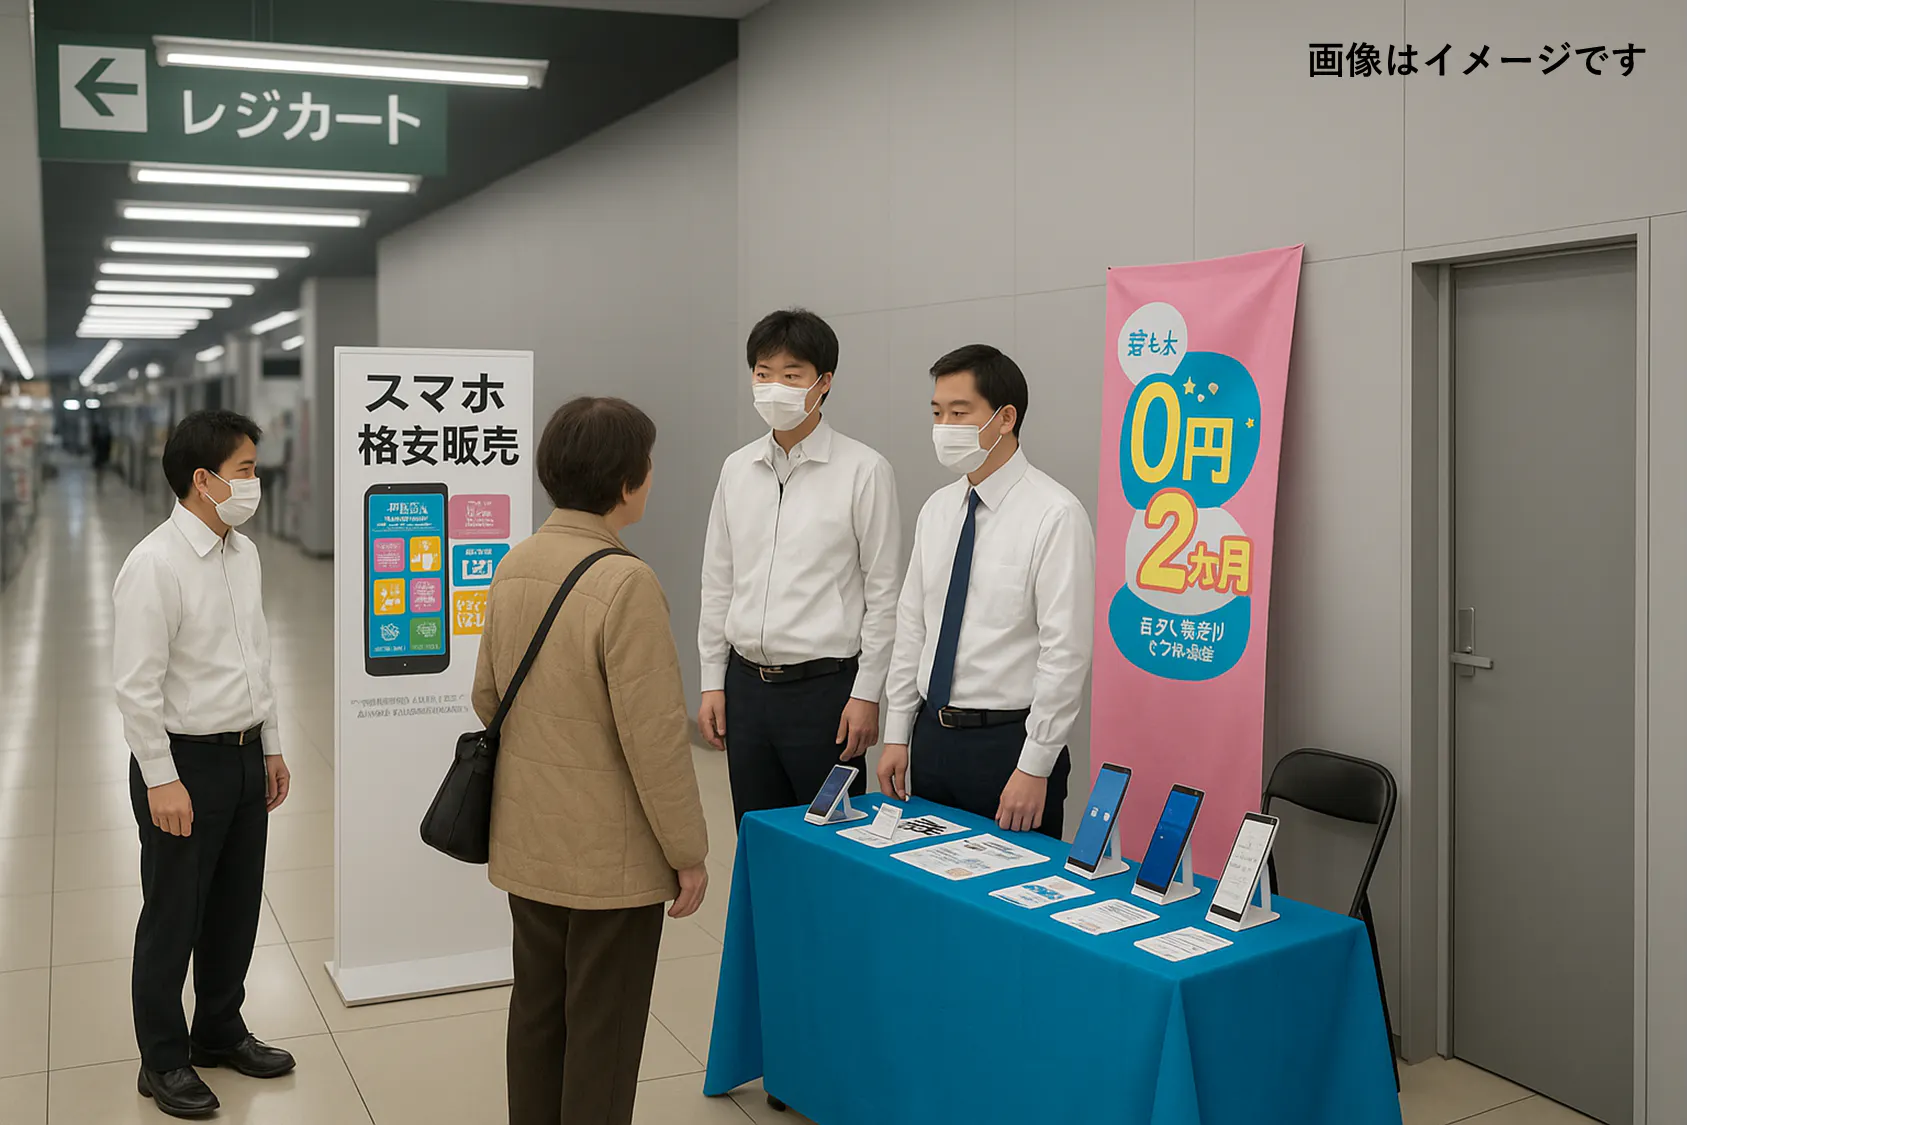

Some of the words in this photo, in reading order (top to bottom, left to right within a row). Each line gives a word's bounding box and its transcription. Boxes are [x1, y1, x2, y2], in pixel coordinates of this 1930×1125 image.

[182, 88, 421, 146] レジカート
[365, 373, 505, 414] スマホ
[1131, 381, 1234, 484] 0円
